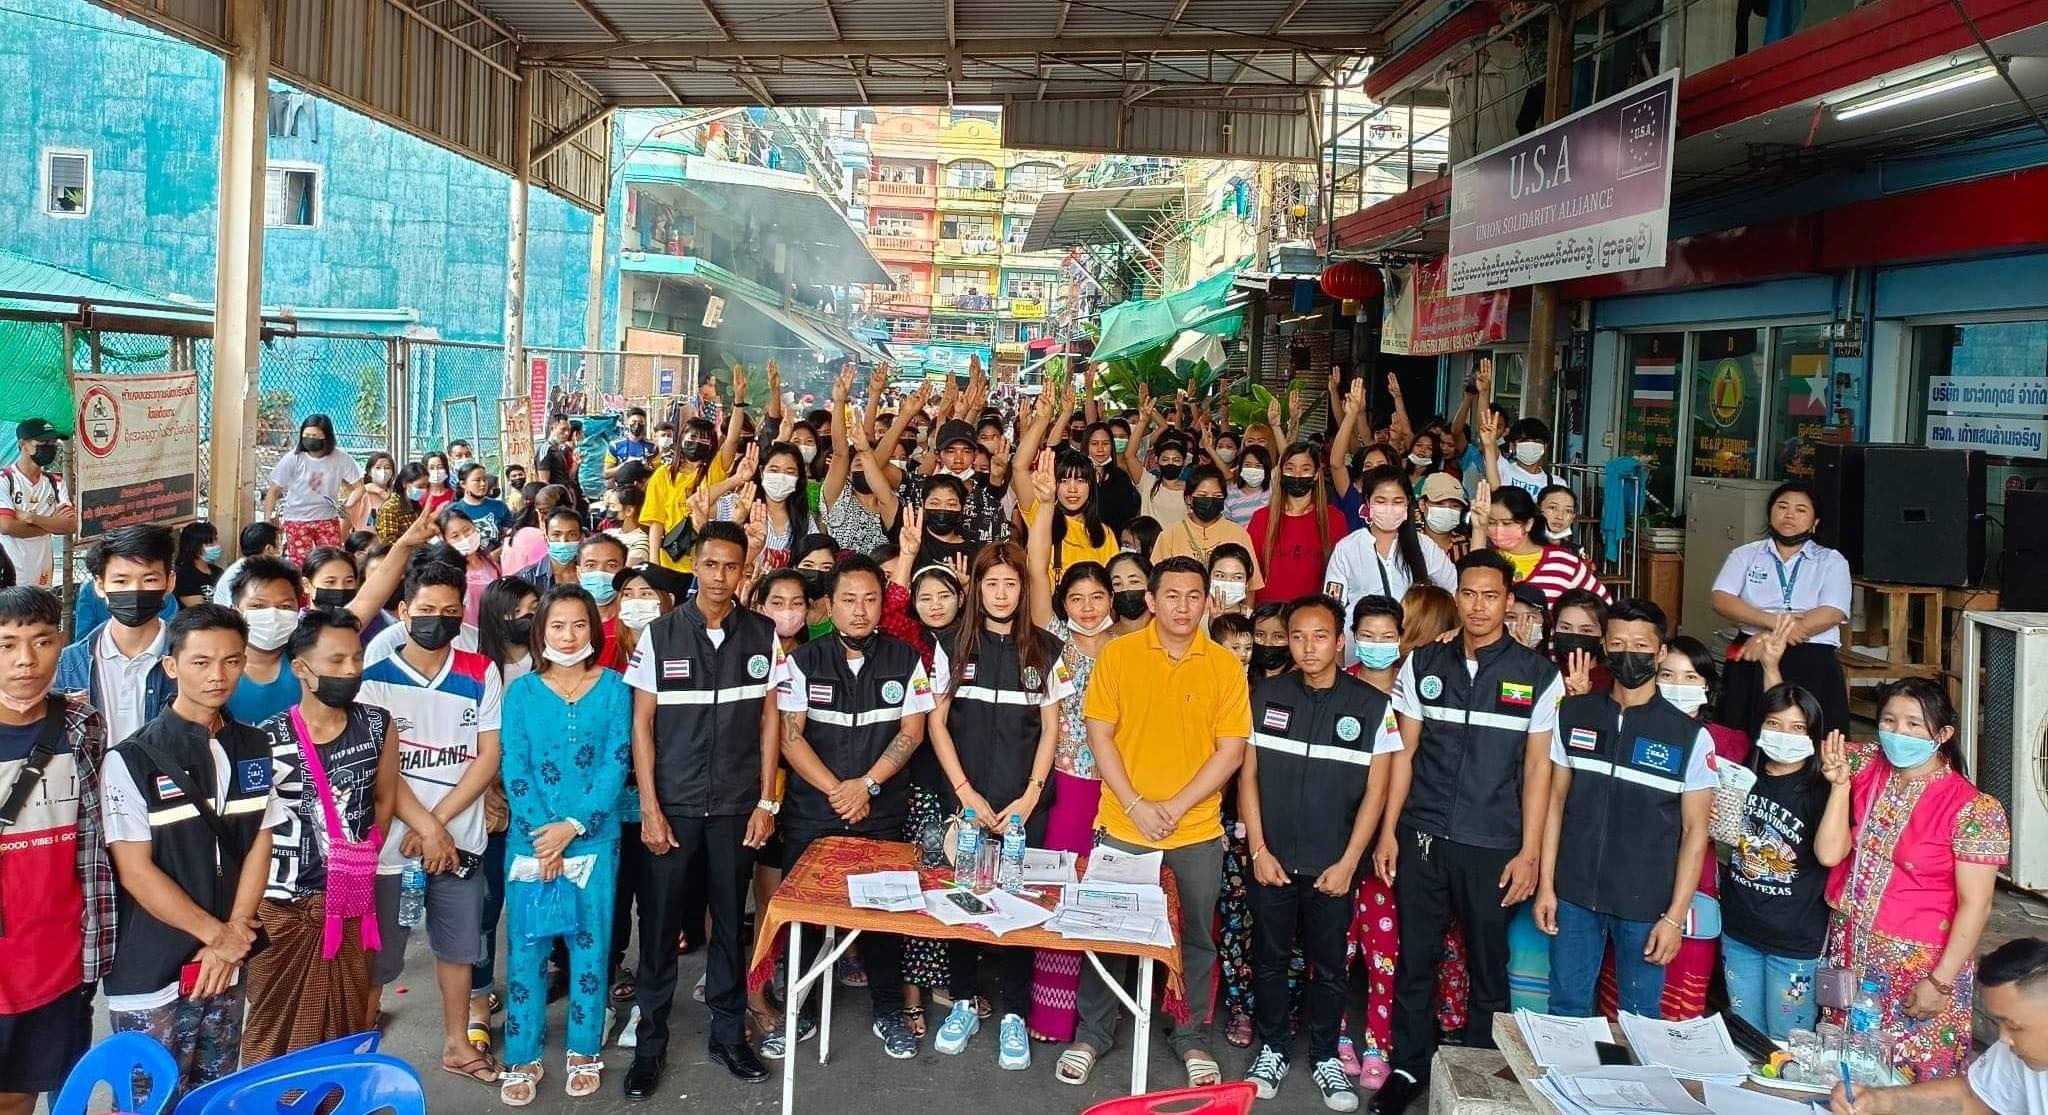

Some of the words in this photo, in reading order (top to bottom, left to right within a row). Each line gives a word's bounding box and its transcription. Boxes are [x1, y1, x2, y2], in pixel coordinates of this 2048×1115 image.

[1633, 124, 1651, 139] U.S.A
[1510, 135, 1571, 200] U.S.A
[1476, 219, 1501, 241] UNION
[1503, 203, 1557, 235] SOLIDARITY
[1559, 187, 1614, 220] ALLIANCE
[1753, 882, 1792, 895] TEXAS
